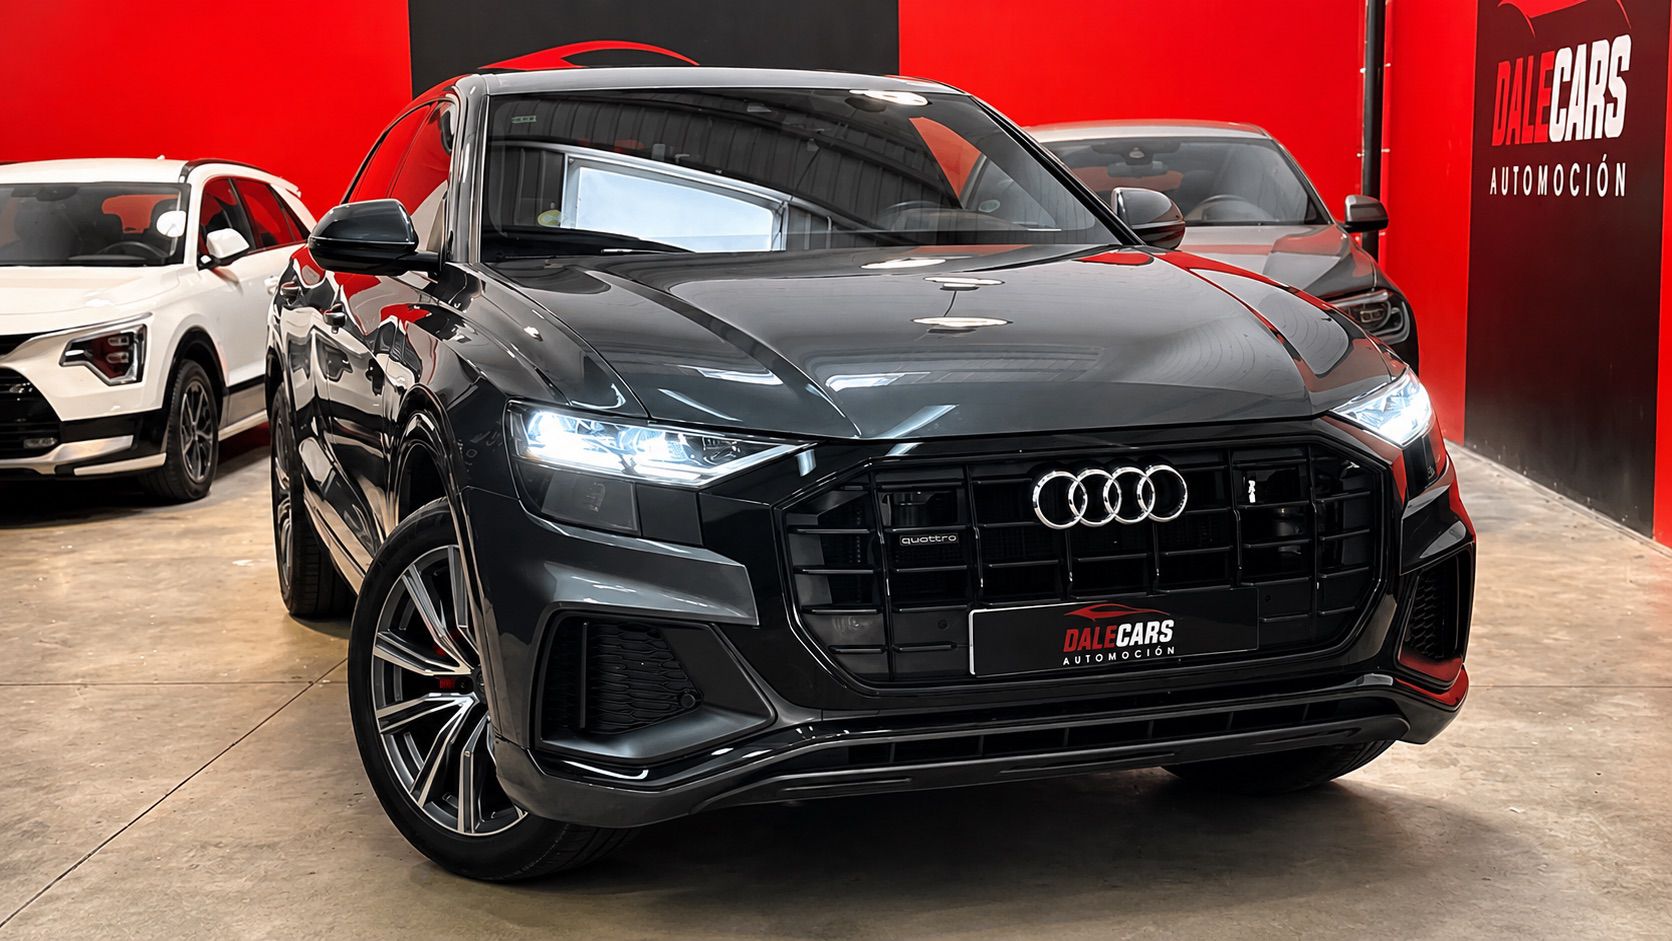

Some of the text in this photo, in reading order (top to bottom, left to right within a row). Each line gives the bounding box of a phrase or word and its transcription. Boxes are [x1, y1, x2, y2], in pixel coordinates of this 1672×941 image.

[1491, 34, 1632, 147] DALECARS
[1489, 153, 1627, 198] AUTOMOCIÓN
[901, 535, 957, 545] quattro
[1063, 619, 1175, 653] DALECARS
[1062, 645, 1175, 666] AUTOMOCIÓN
